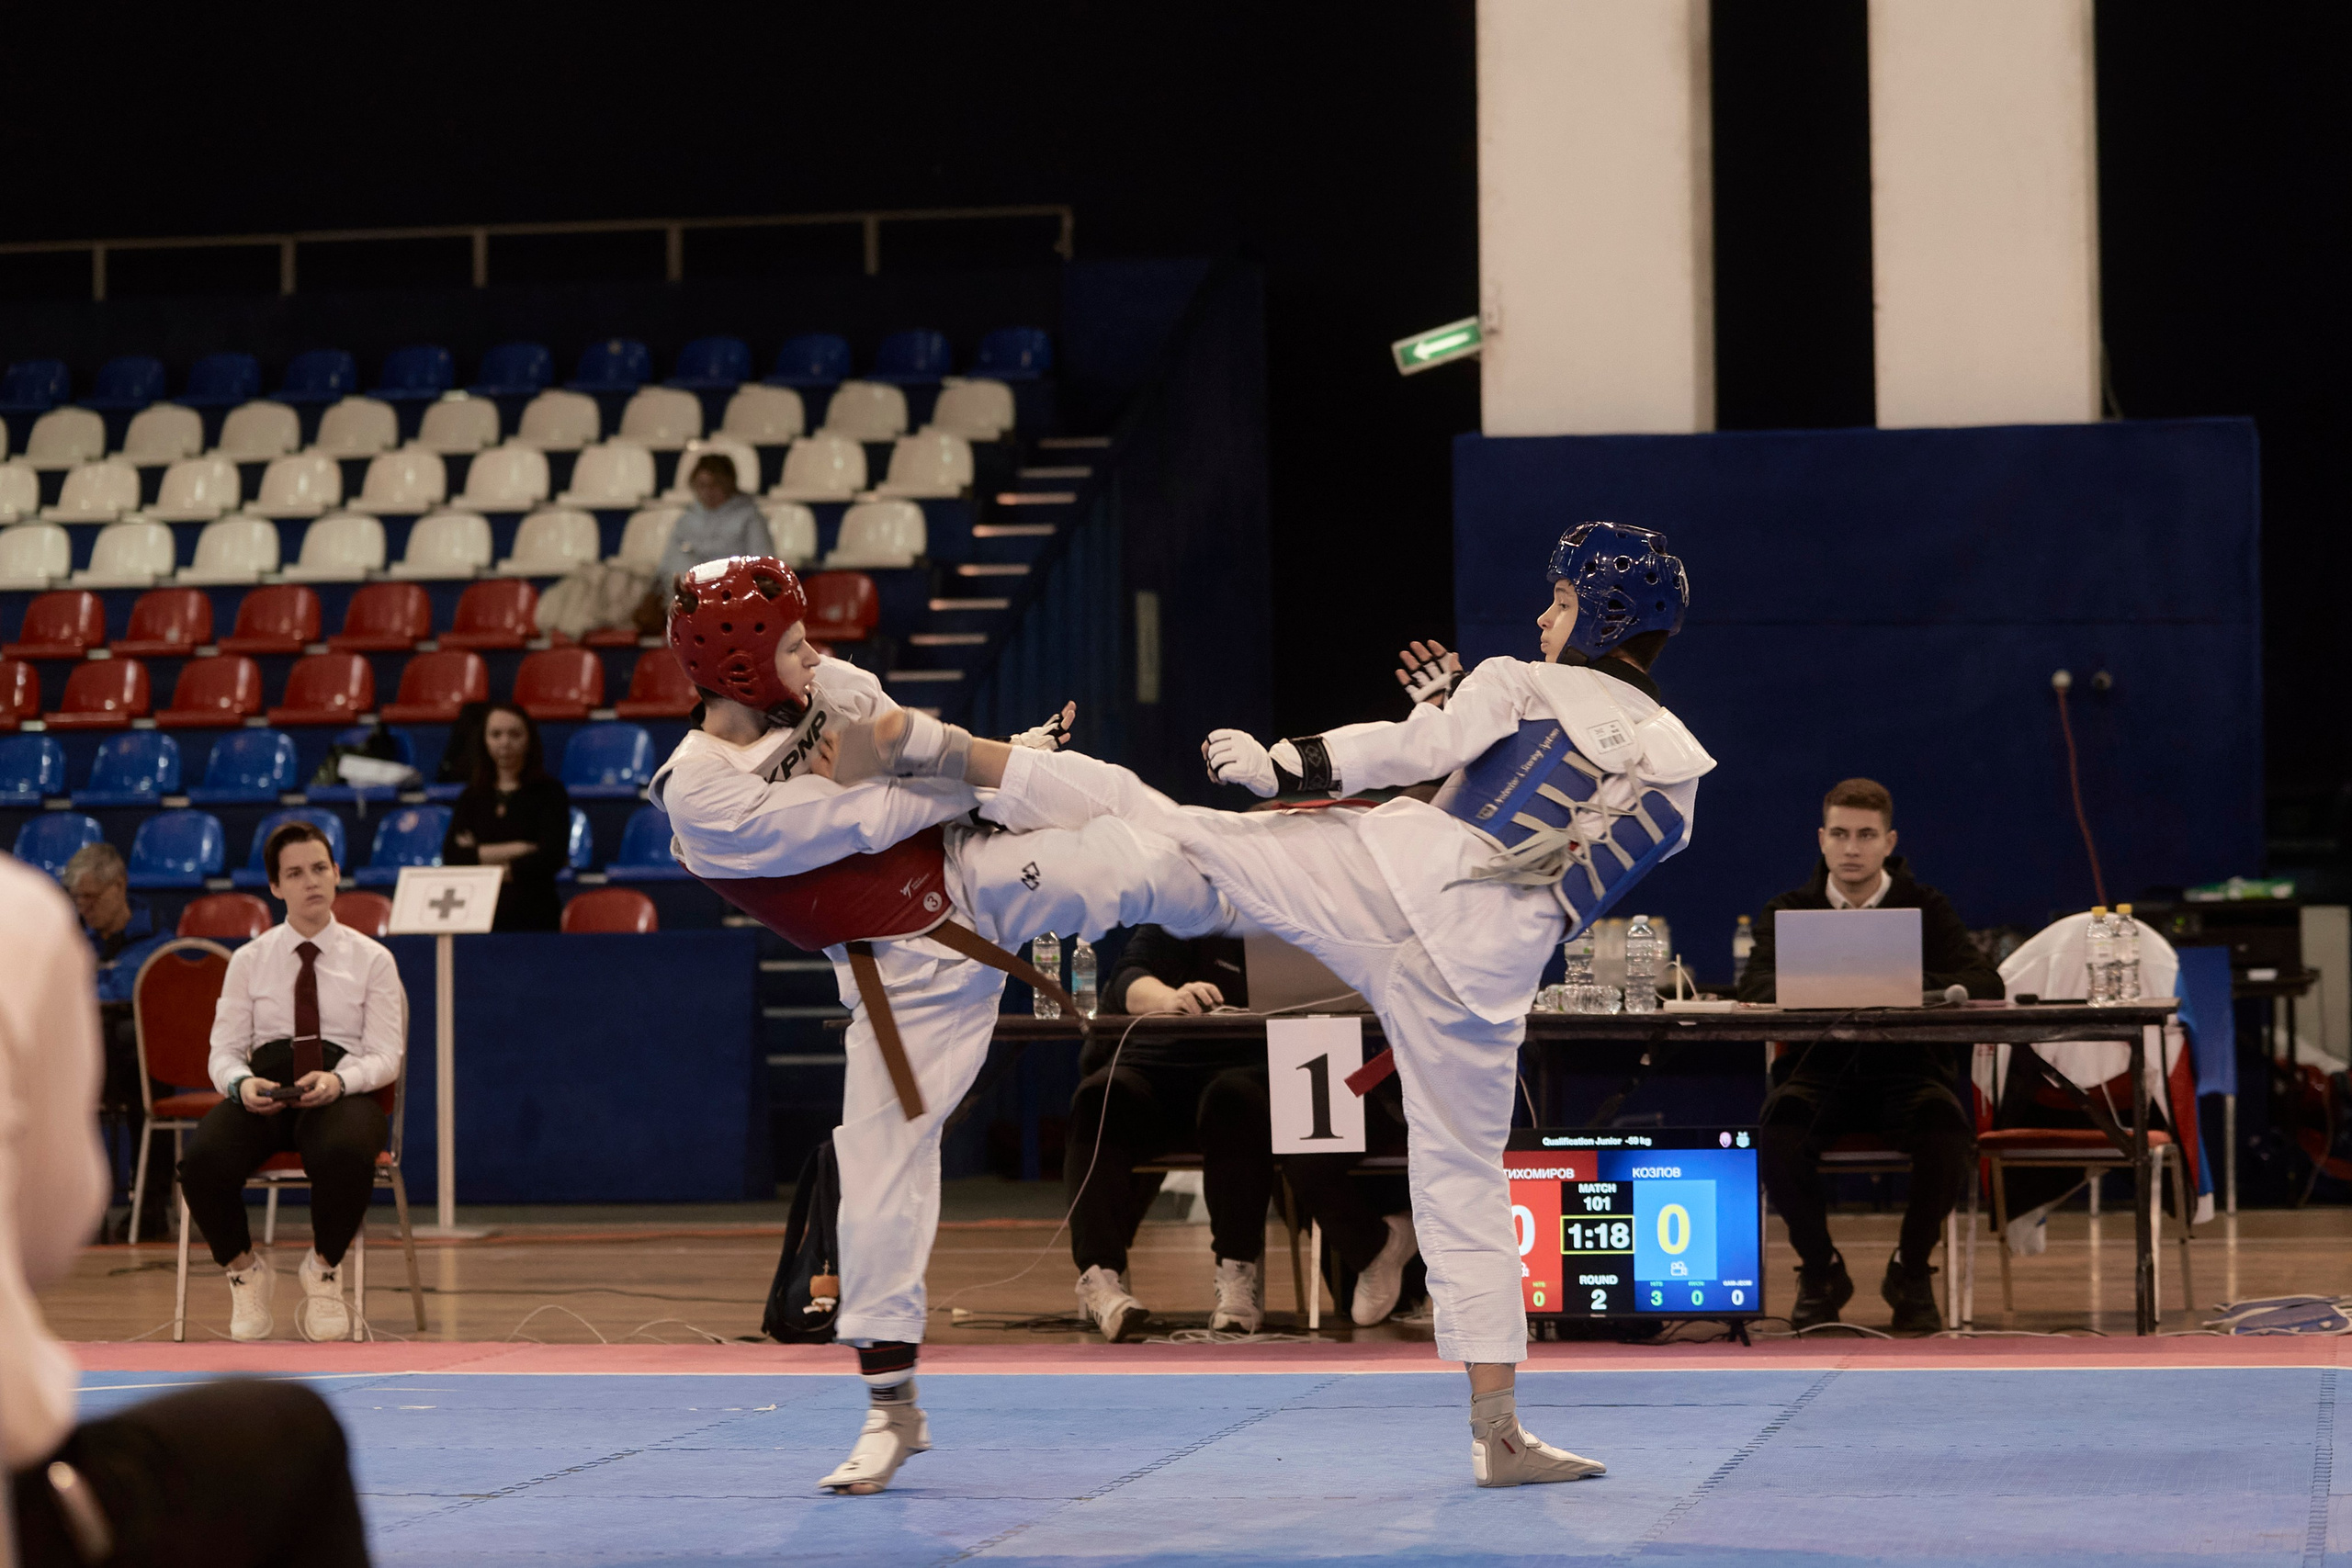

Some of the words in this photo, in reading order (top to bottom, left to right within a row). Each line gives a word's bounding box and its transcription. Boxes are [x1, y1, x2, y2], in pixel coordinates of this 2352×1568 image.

[927, 895, 939, 908] 3
[1295, 1053, 1344, 1140] 1
[1542, 1136, 1595, 1146] Qualification
[1595, 1136, 1623, 1146] Junior
[1639, 1135, 1653, 1147] kg
[1632, 1167, 1681, 1179] КОЗЛОВ
[1577, 1182, 1617, 1193] MATCH
[1583, 1196, 1611, 1212] 101
[1567, 1222, 1631, 1249] 1:18
[1657, 1203, 1690, 1255] 0
[1578, 1274, 1619, 1285] ROUND
[1532, 1291, 1546, 1307] 0
[1590, 1288, 1608, 1311] 2
[1650, 1290, 1664, 1306] 3
[1690, 1289, 1704, 1306] 0
[1731, 1289, 1745, 1306] 0
